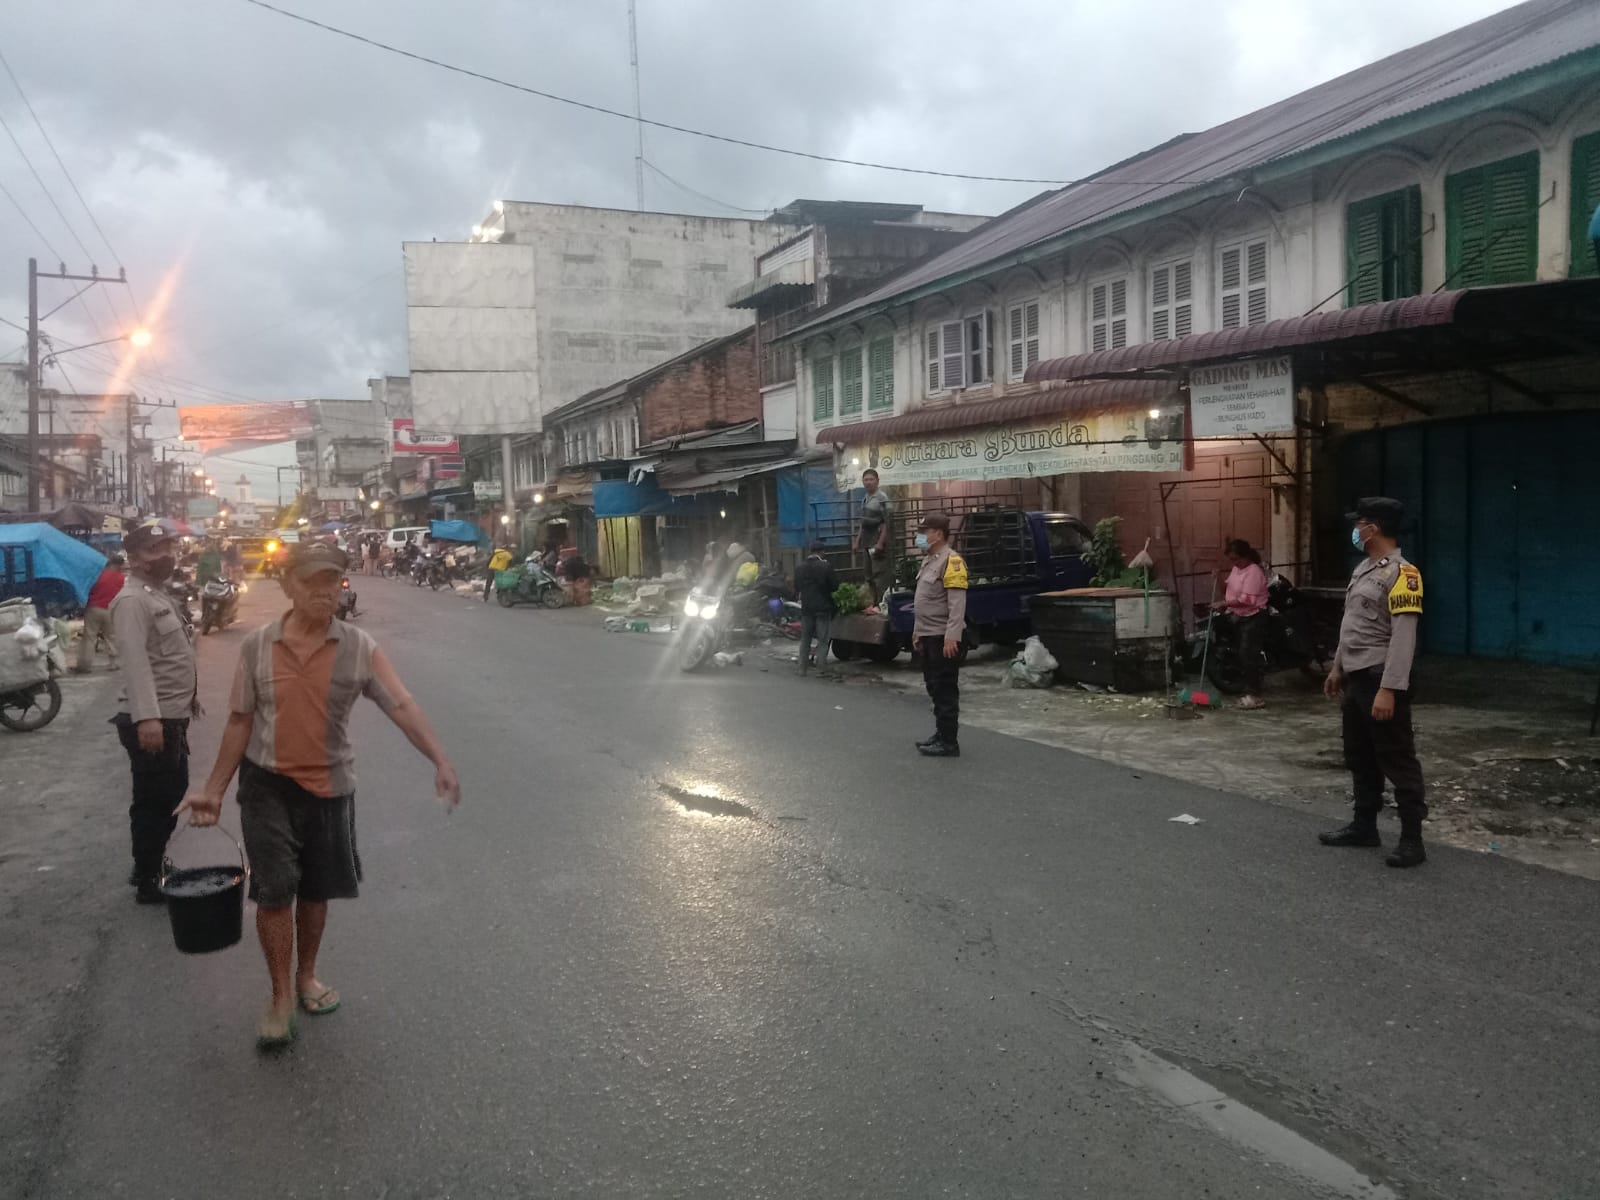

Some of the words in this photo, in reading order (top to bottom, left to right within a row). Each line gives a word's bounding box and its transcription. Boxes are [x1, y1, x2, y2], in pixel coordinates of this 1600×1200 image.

[1191, 364, 1250, 386] GADING
[1256, 359, 1289, 378] MAS
[881, 438, 978, 470] Mutiara
[984, 420, 1090, 462] Bunda
